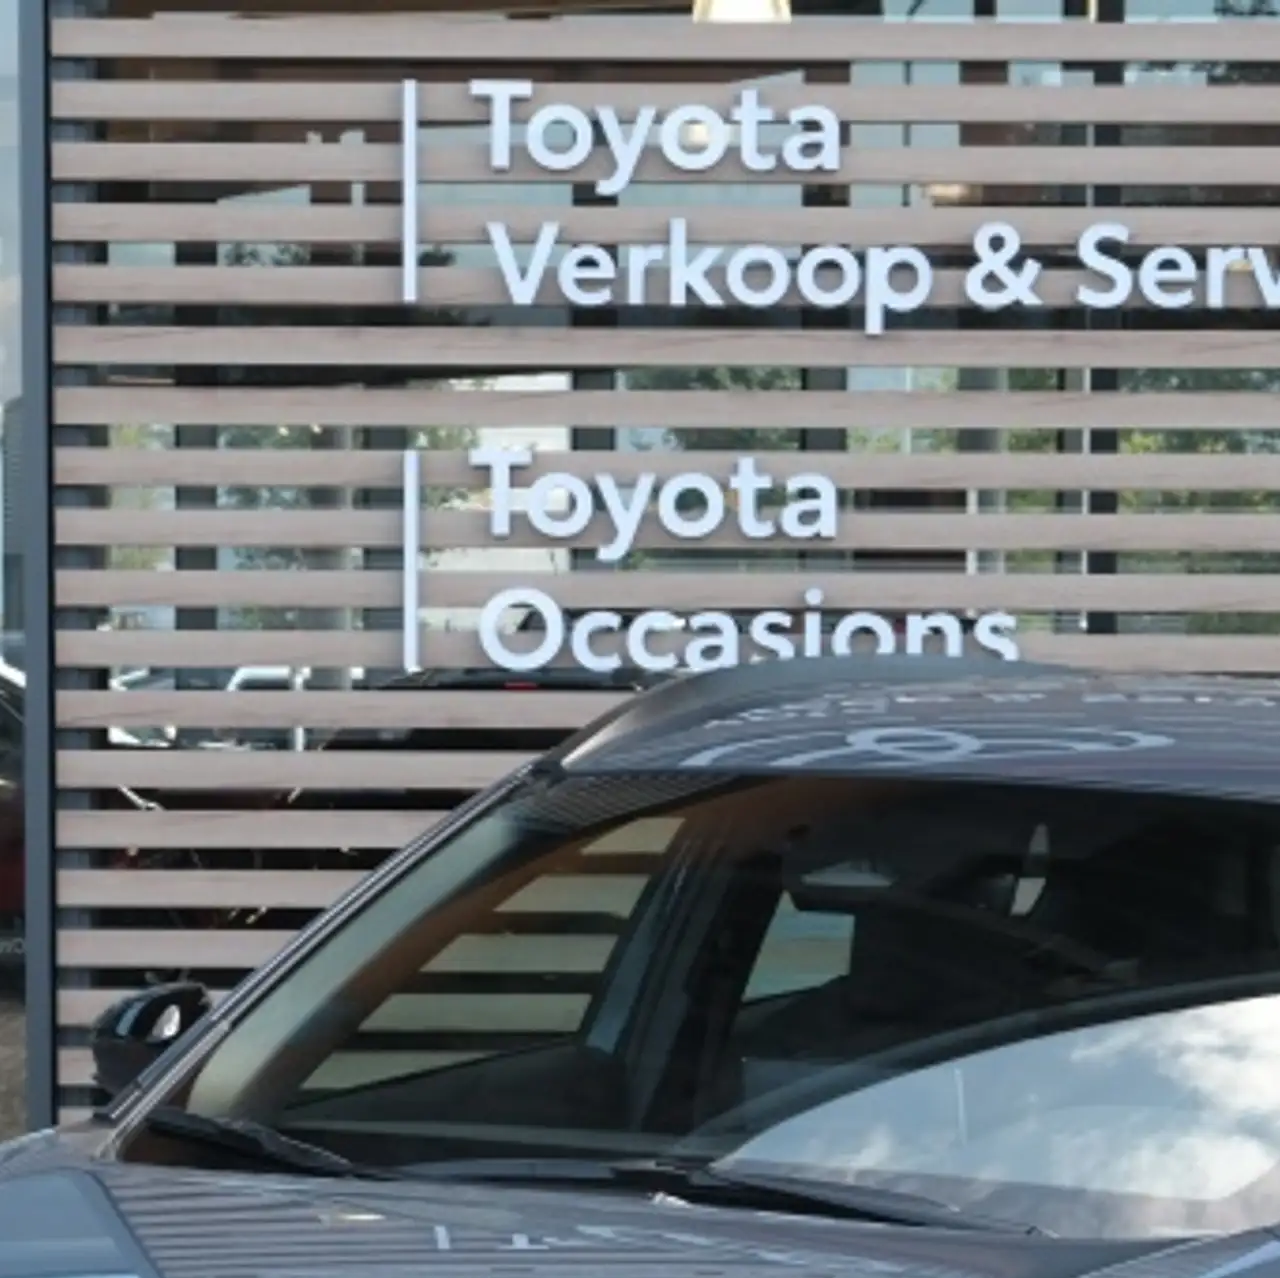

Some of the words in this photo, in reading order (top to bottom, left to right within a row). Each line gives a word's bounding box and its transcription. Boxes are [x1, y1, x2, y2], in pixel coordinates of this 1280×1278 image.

[469, 79, 841, 196] Toyota
[486, 217, 934, 336] Verkoop
[964, 221, 1043, 310] &
[469, 449, 838, 561] Toyota
[478, 587, 1020, 673] Occasions
